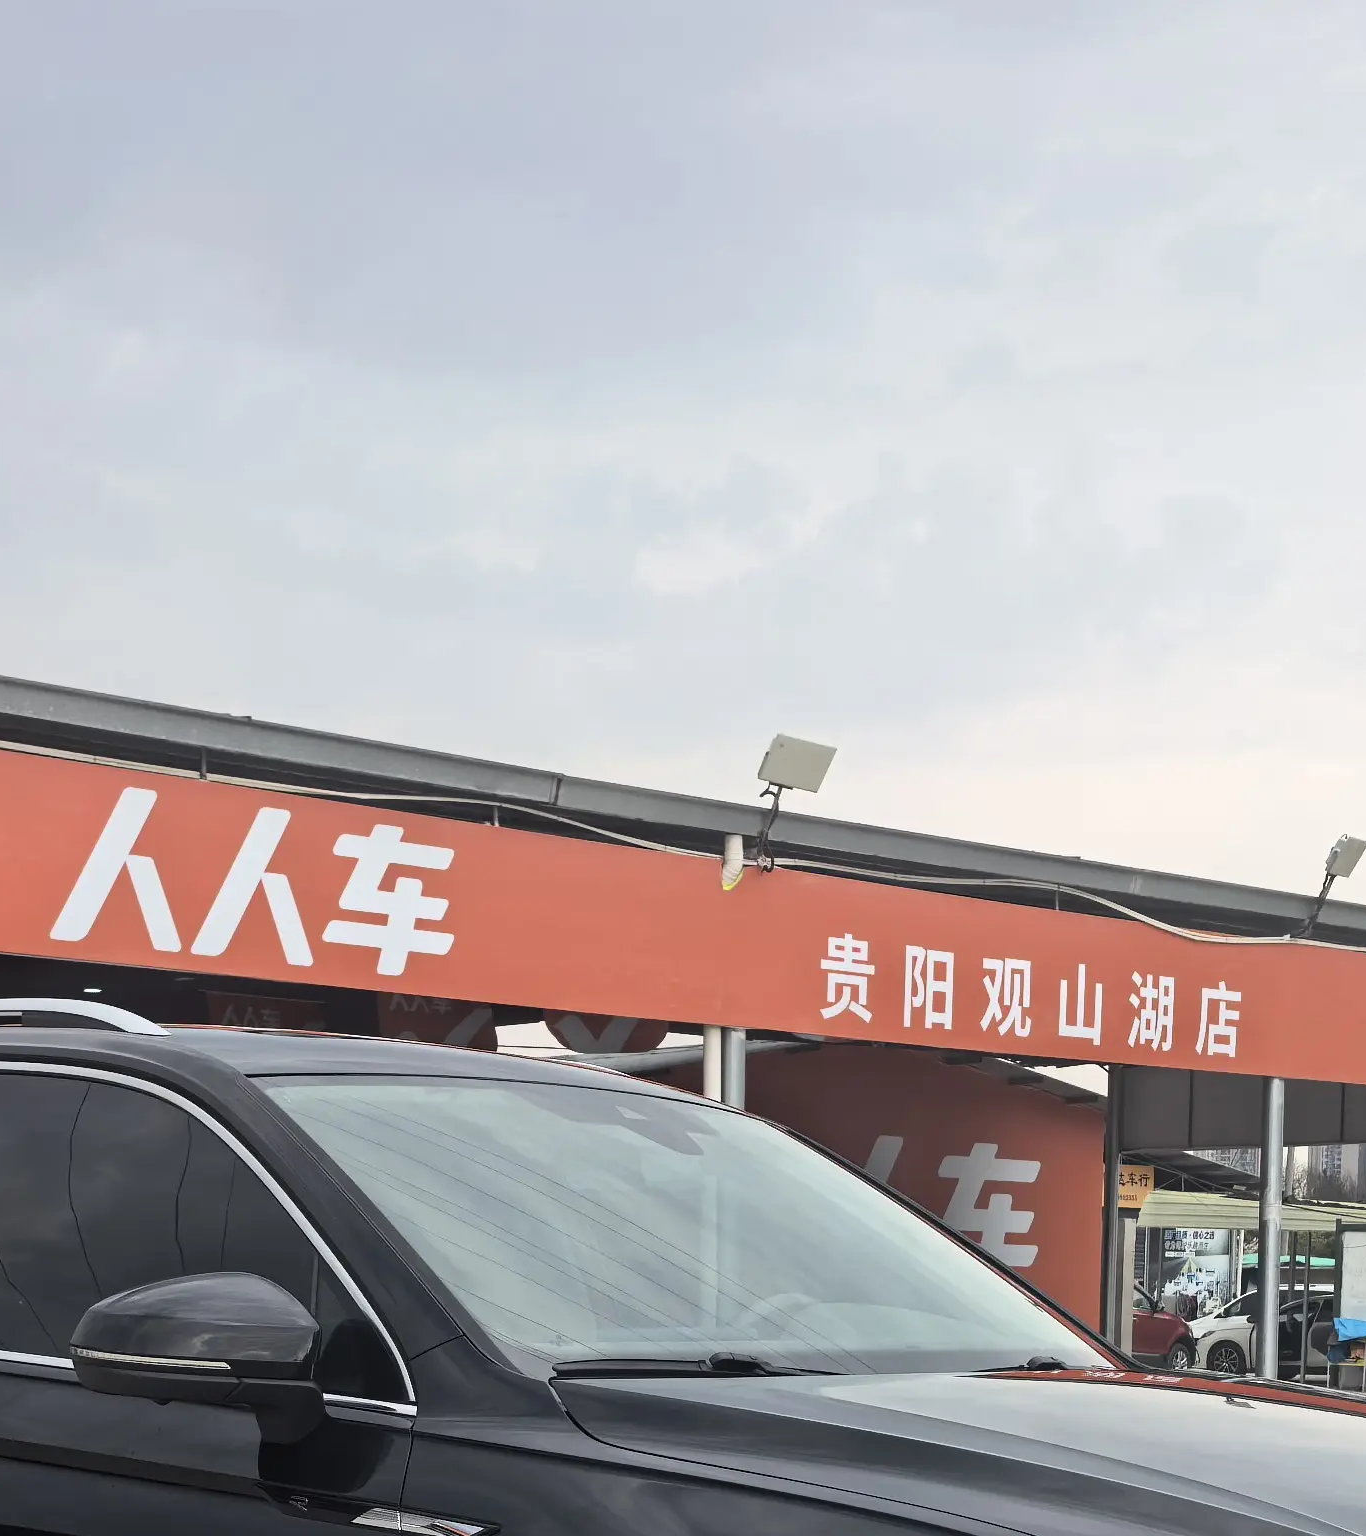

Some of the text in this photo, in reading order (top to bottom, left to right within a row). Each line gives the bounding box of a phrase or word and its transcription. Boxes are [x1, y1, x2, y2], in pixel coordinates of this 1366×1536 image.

[49, 786, 455, 976] 人人车
[820, 932, 1243, 1058] 贵阳观山湖店
